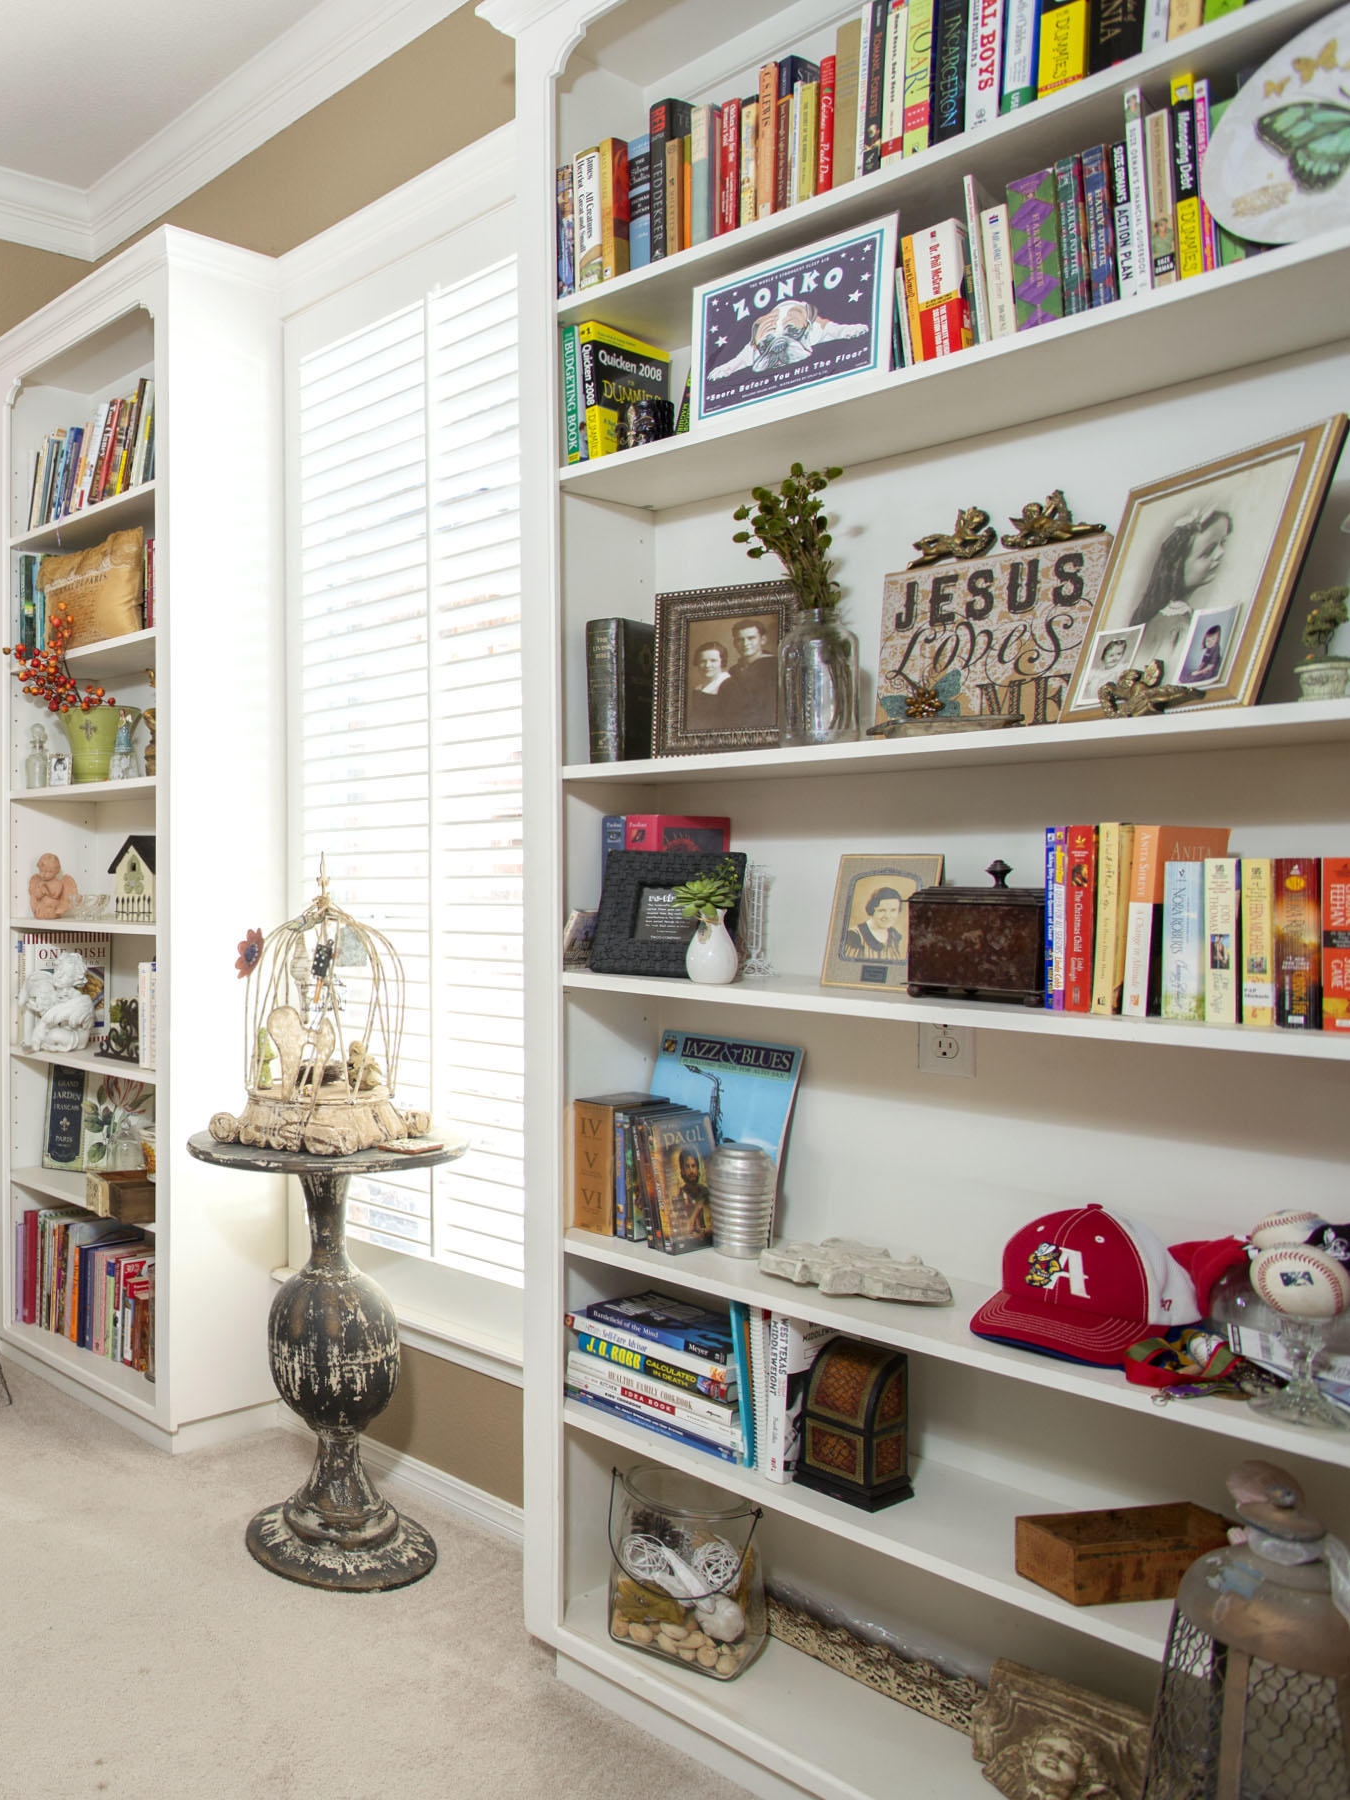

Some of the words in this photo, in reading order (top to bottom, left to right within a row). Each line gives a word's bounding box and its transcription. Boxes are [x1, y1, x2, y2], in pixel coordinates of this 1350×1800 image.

[978, 30, 996, 91] BOYS
[1052, 17, 1070, 78] DUMMIES
[762, 71, 771, 83] C.
[940, 15, 962, 128] INCARCERON
[762, 84, 770, 93] S.
[651, 105, 666, 134] RED
[761, 95, 771, 128] LEWIS
[1175, 111, 1191, 164] Managing
[577, 160, 585, 189] Herriot
[586, 155, 596, 180] James
[652, 160, 663, 188] TED
[1179, 164, 1193, 190] Debt
[586, 192, 594, 203] All
[1095, 188, 1103, 226] HARRY
[586, 204, 595, 239] Creatures
[653, 190, 664, 244] DEKKER
[1067, 199, 1075, 233] HARRY
[1117, 210, 1128, 247] ACTION
[579, 230, 587, 253] Small
[1032, 213, 1042, 250] HARRY
[1181, 211, 1199, 272] DUMMIES
[930, 244, 940, 254] Dr.
[930, 255, 941, 269] Phil
[1068, 238, 1077, 276] POTTER
[1097, 229, 1106, 267] POTTER
[1035, 252, 1044, 288] POTTER
[1120, 252, 1133, 281] PLAN
[733, 266, 844, 321] ZONKO
[930, 268, 942, 296] McGraw
[564, 342, 576, 412] BUDGETING
[582, 344, 593, 382] Quicken
[598, 349, 637, 374] Quicken
[638, 363, 662, 382] 2008
[739, 378, 769, 392] Before
[773, 372, 790, 382] You
[794, 365, 809, 377] Hit
[813, 359, 831, 370] The
[836, 347, 868, 364] Floor"
[586, 382, 595, 406] 2008
[98, 427, 113, 458] Clancy
[567, 416, 577, 450] BOOK
[895, 552, 1084, 632] JESUS
[976, 673, 1072, 726] ME
[1139, 832, 1152, 861] ANITA
[1137, 863, 1149, 897] SHREVE
[1074, 890, 1083, 902] The
[1171, 887, 1187, 915] NORA
[1330, 884, 1344, 927] FEEHAN
[1073, 903, 1083, 934] Christmas
[1209, 896, 1219, 933] THOMAS
[1073, 935, 1083, 952] Child
[1170, 917, 1184, 954] ROBERTS
[1331, 960, 1342, 989] GAME
[682, 1039, 720, 1059] JAZZ
[720, 1036, 742, 1064] &
[741, 1049, 792, 1070] BLUES
[53, 1091, 81, 1100] JARDIN
[55, 1135, 73, 1143] PARIS
[581, 1119, 602, 1136] IV
[663, 1125, 706, 1149] PAUL
[584, 1151, 599, 1169] V
[581, 1188, 603, 1209] VI
[1043, 1246, 1090, 1299] A
[593, 1310, 623, 1326] Battlefield
[631, 1323, 642, 1333] the
[642, 1326, 659, 1338] Mind
[780, 1318, 789, 1343] WEST
[586, 1338, 595, 1351] J.
[599, 1343, 610, 1357] D.
[611, 1345, 642, 1370] ROBB
[688, 1343, 709, 1356] Meyer
[769, 1320, 779, 1396] MIDDLEWEIGHT
[778, 1345, 788, 1375] TEXAS
[607, 1370, 635, 1390] HEALTHY
[636, 1379, 658, 1397] FAMILY
[645, 1359, 697, 1384] CALCULATED
[653, 1370, 663, 1378] IN
[664, 1373, 689, 1388] DEATH
[623, 1389, 645, 1403] IDEA
[650, 1399, 672, 1413] BOOK
